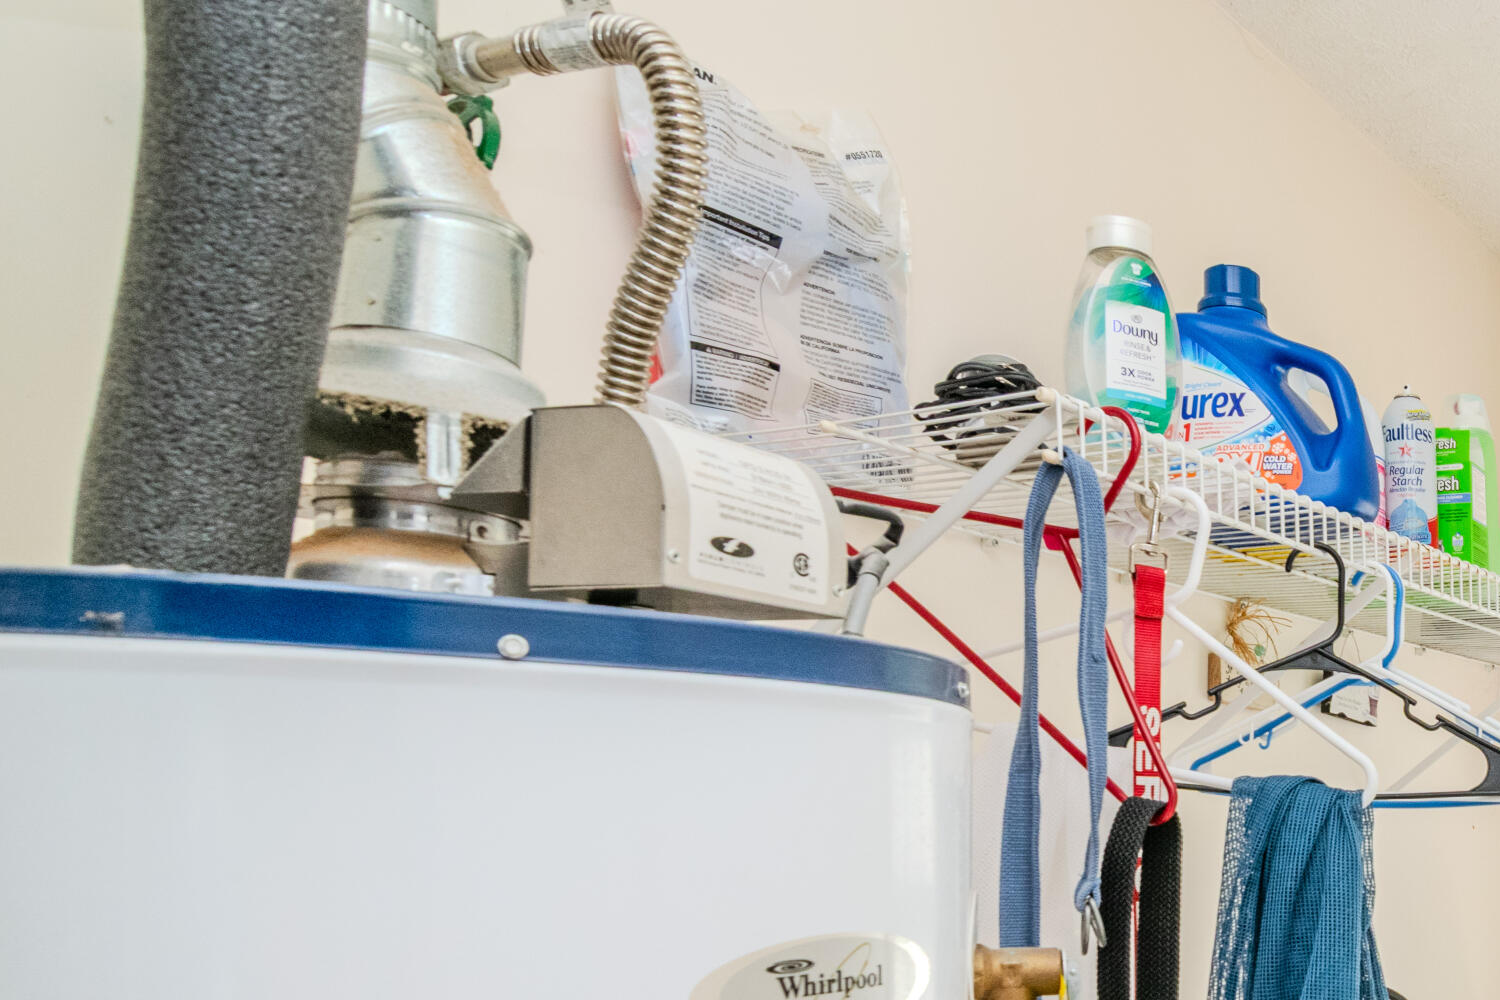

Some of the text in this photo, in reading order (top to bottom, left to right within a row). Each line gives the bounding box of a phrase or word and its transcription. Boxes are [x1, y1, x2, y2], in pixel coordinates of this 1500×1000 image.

[1112, 319, 1158, 346] Downy
[1120, 367, 1136, 378] 3X
[1180, 391, 1247, 420] urex
[1184, 422, 1191, 442] 1
[1382, 423, 1433, 443] Faultless
[1216, 443, 1265, 451] ADVANCED
[1436, 437, 1457, 449] resh
[1263, 455, 1286, 463] COLD
[1262, 462, 1293, 470] WATER
[1389, 465, 1425, 477] Regular
[1391, 476, 1423, 487] Starch
[776, 964, 884, 999] Whirlpool
